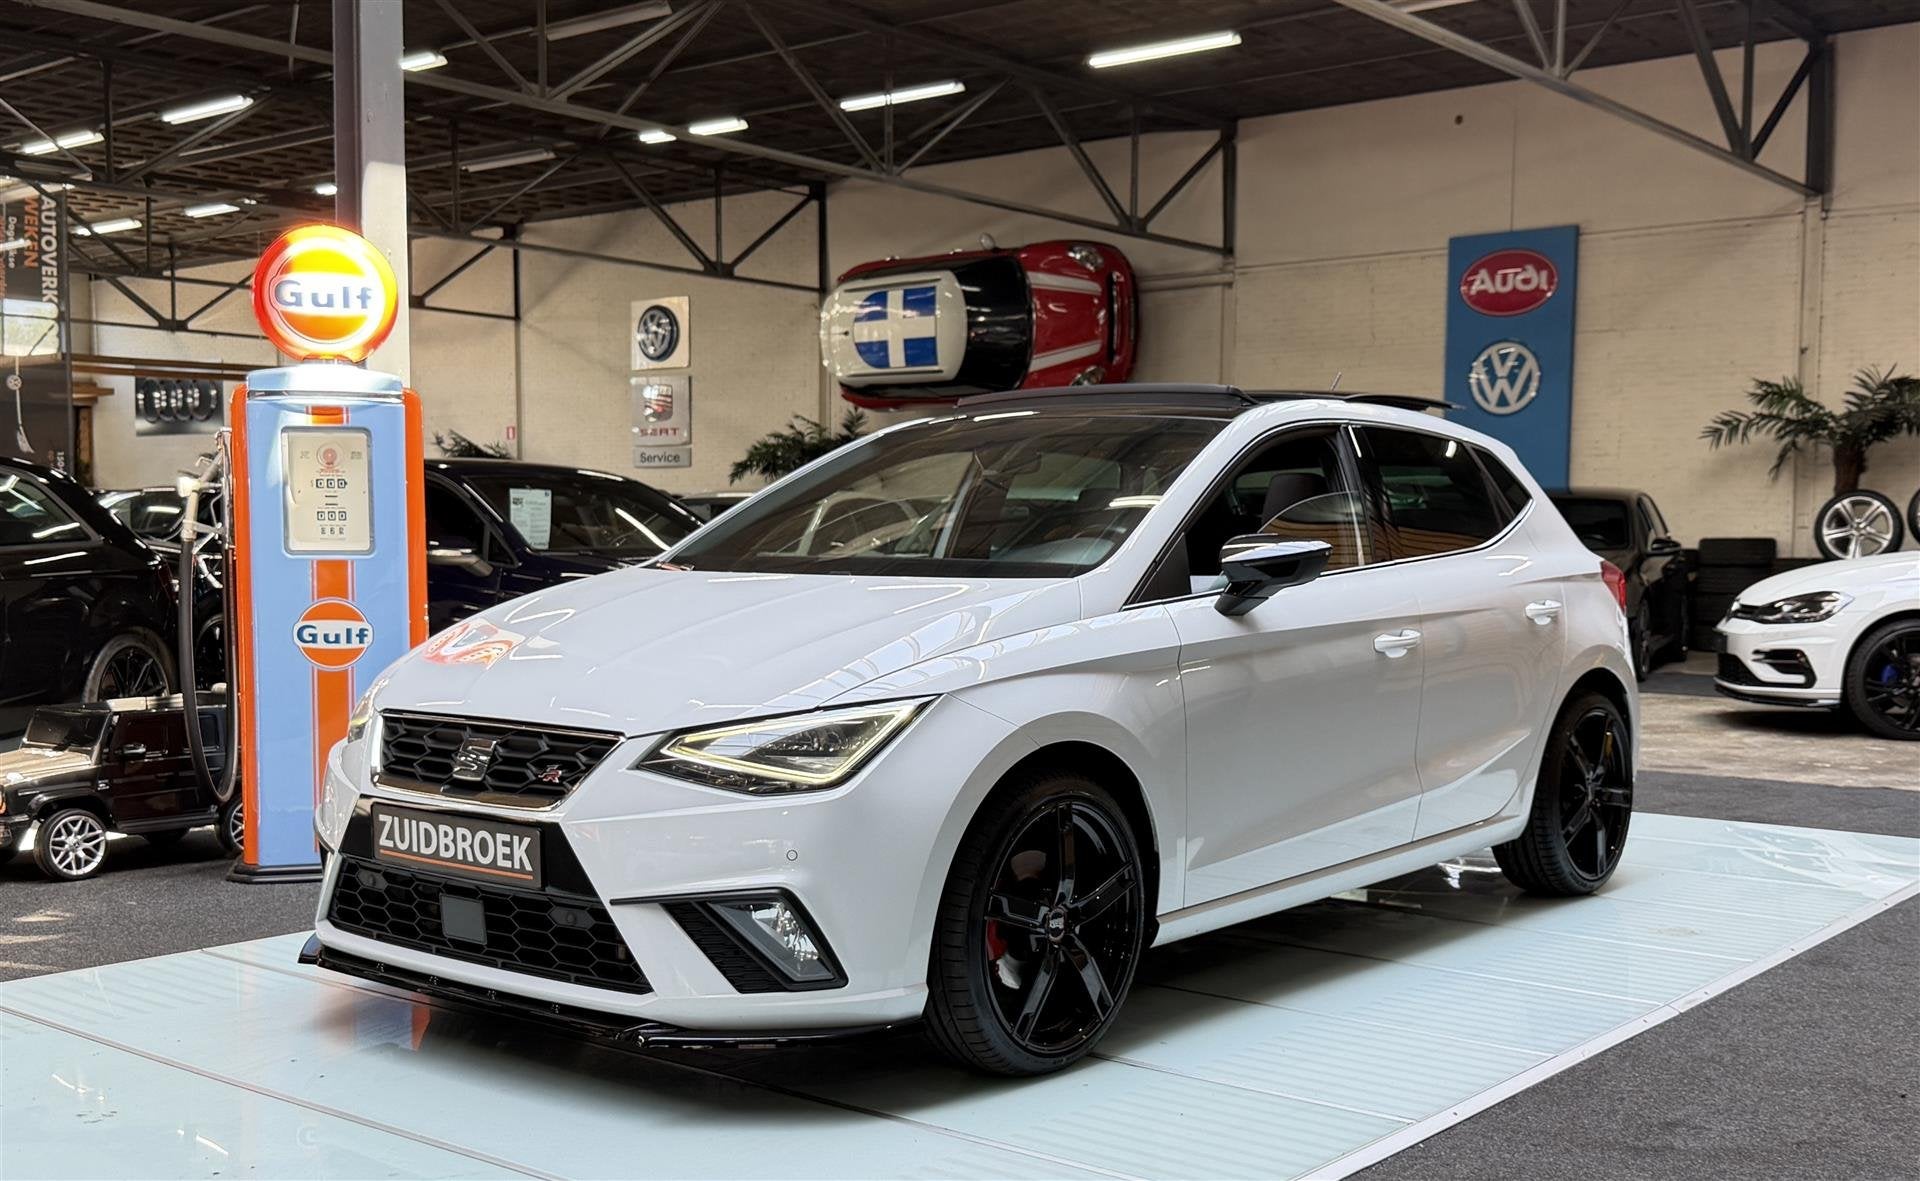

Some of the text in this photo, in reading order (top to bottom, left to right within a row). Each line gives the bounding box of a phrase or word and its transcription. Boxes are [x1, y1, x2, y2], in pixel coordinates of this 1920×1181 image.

[274, 279, 373, 309] Gulf
[640, 451, 681, 464] Service
[296, 624, 369, 645] Gulf
[379, 814, 533, 872] ZUIDBROEK
